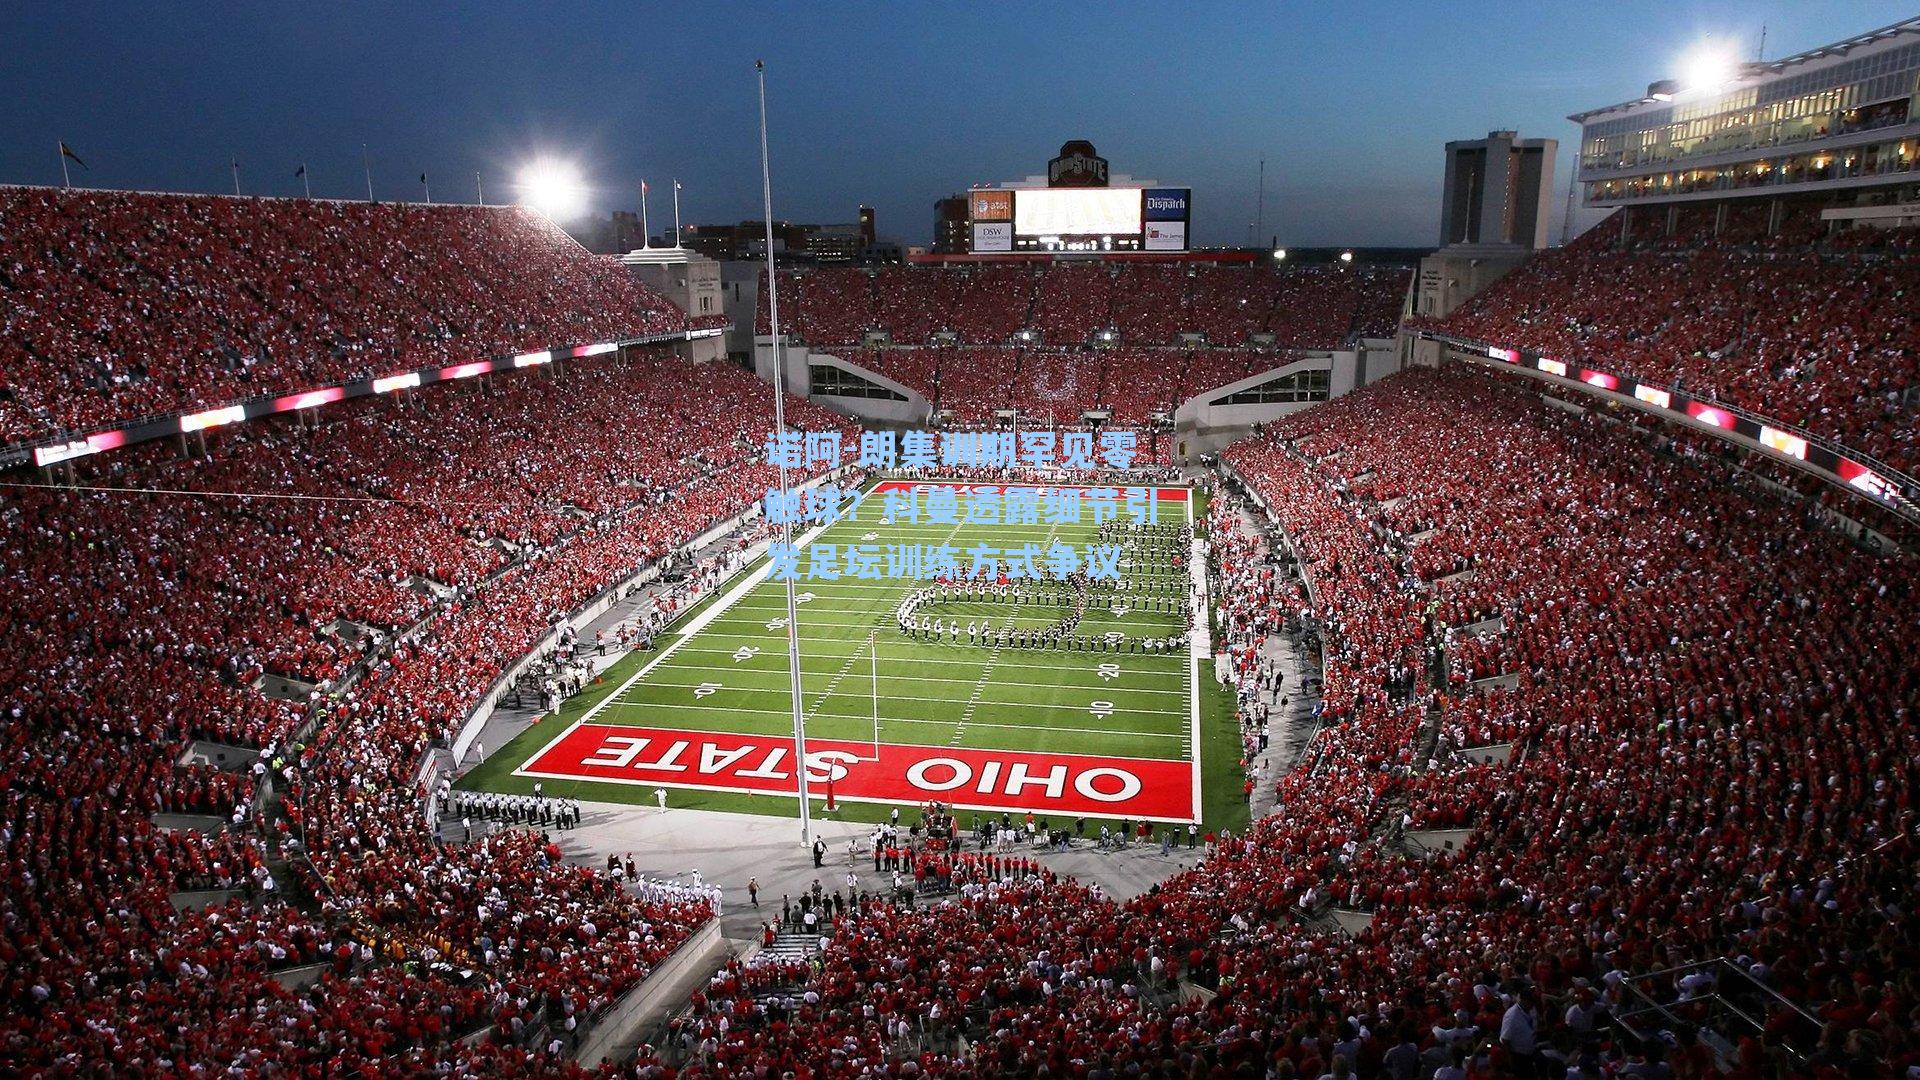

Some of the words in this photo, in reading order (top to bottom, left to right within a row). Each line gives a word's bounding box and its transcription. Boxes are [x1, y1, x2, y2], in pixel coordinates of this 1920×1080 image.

[1147, 198, 1185, 210] Dispatch
[983, 228, 1002, 236] DSW
[1097, 663, 1120, 677] 20
[1089, 701, 1114, 714] 10
[580, 736, 859, 783] STATE
[906, 757, 1142, 802] OHIO
